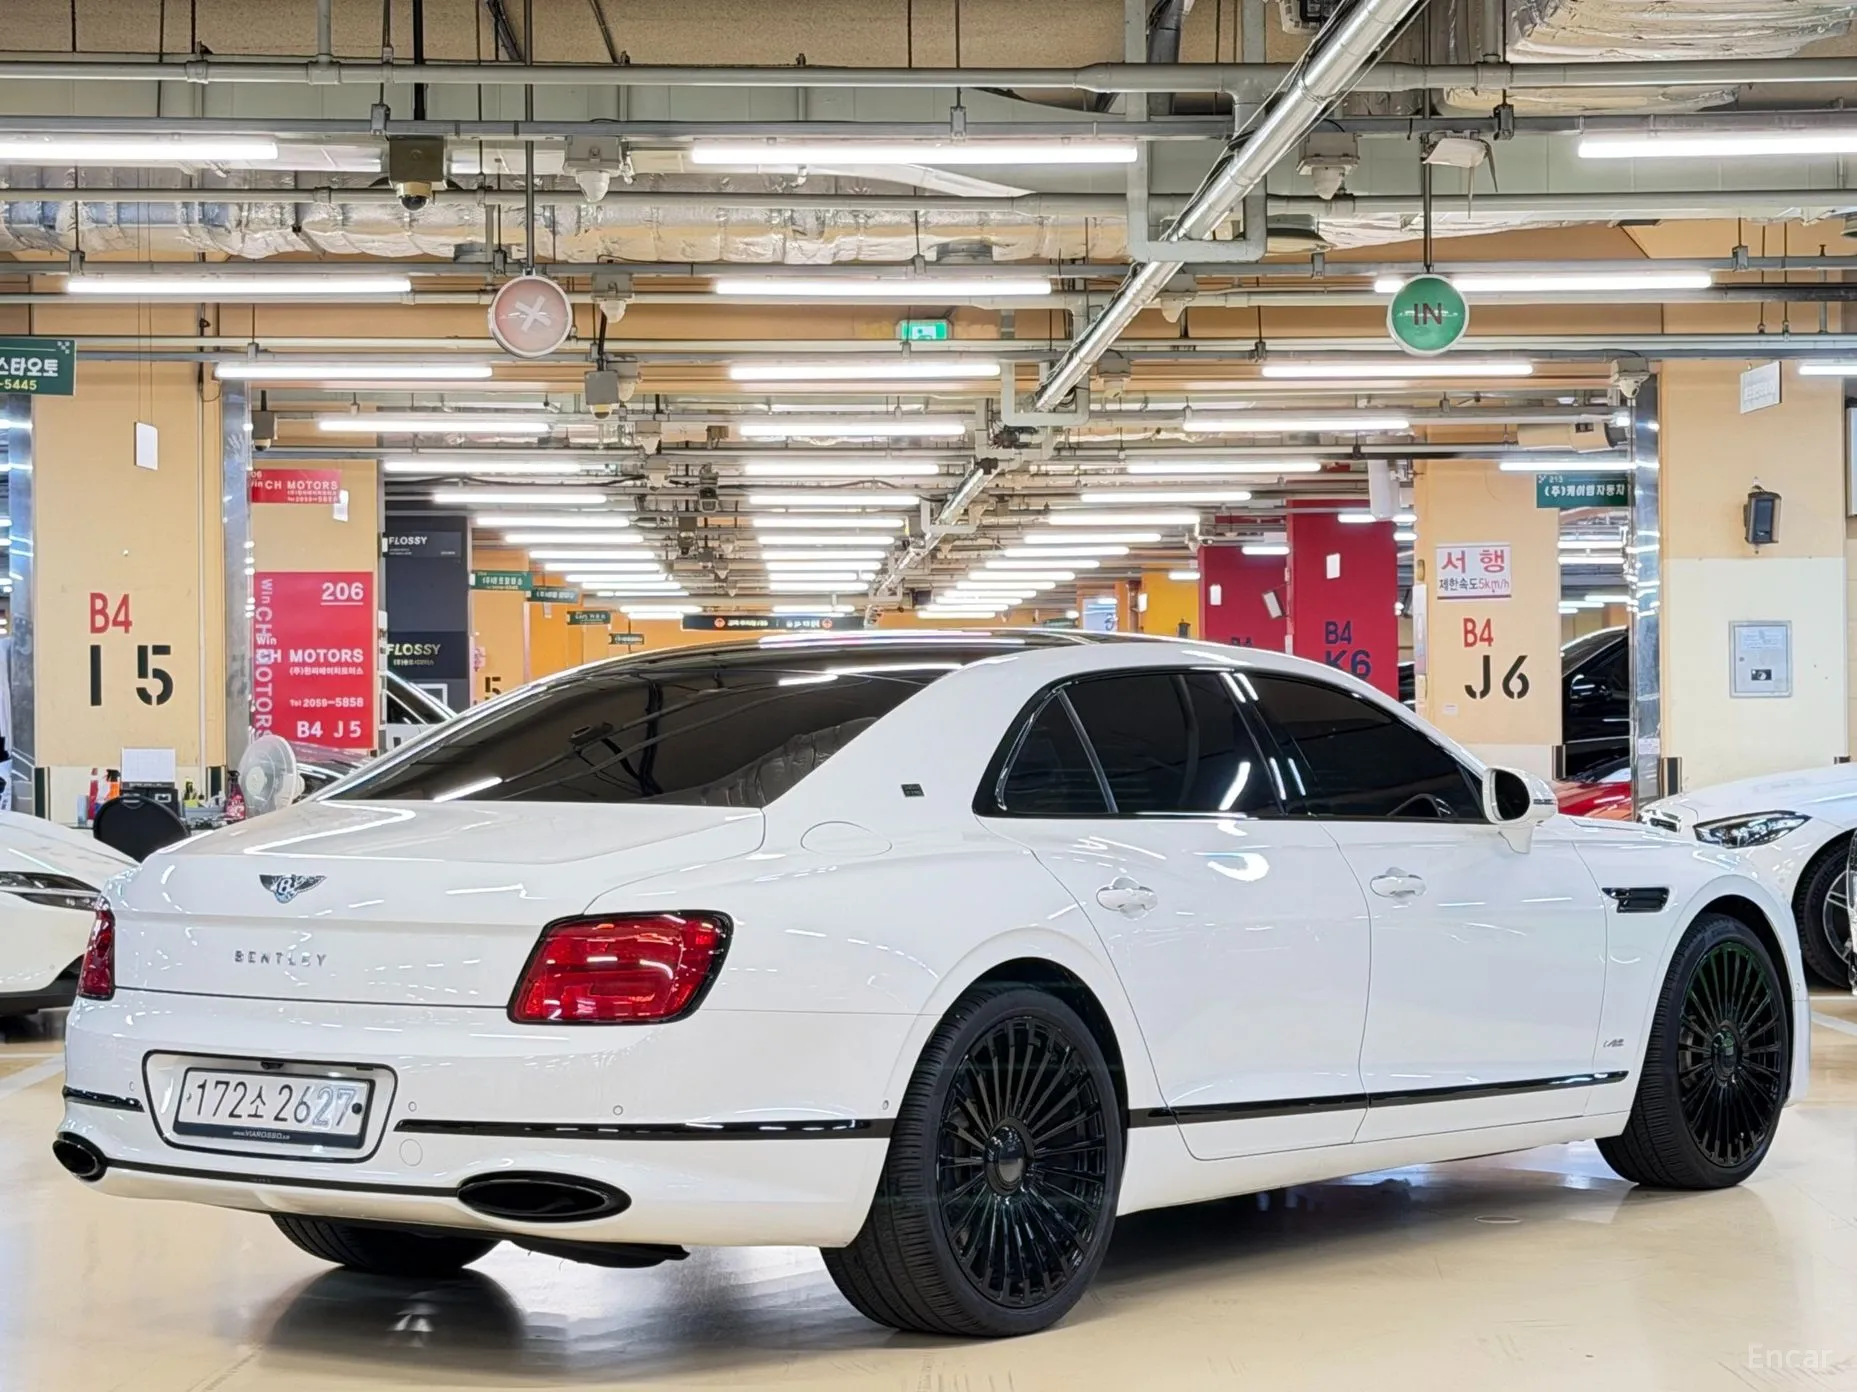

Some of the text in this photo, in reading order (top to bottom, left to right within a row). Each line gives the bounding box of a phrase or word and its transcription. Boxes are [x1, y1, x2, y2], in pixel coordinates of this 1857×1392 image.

[1414, 302, 1442, 325] IN
[287, 480, 338, 490] MOTORS
[388, 536, 427, 545] FLOSSY
[322, 582, 364, 600] 206
[90, 592, 133, 634] B4
[1325, 621, 1352, 644] B4
[1463, 618, 1494, 648] B4
[289, 648, 364, 662] MOTORS
[386, 643, 441, 655] FLOSSY
[297, 721, 322, 738] B4
[235, 949, 326, 967] BENTLEY
